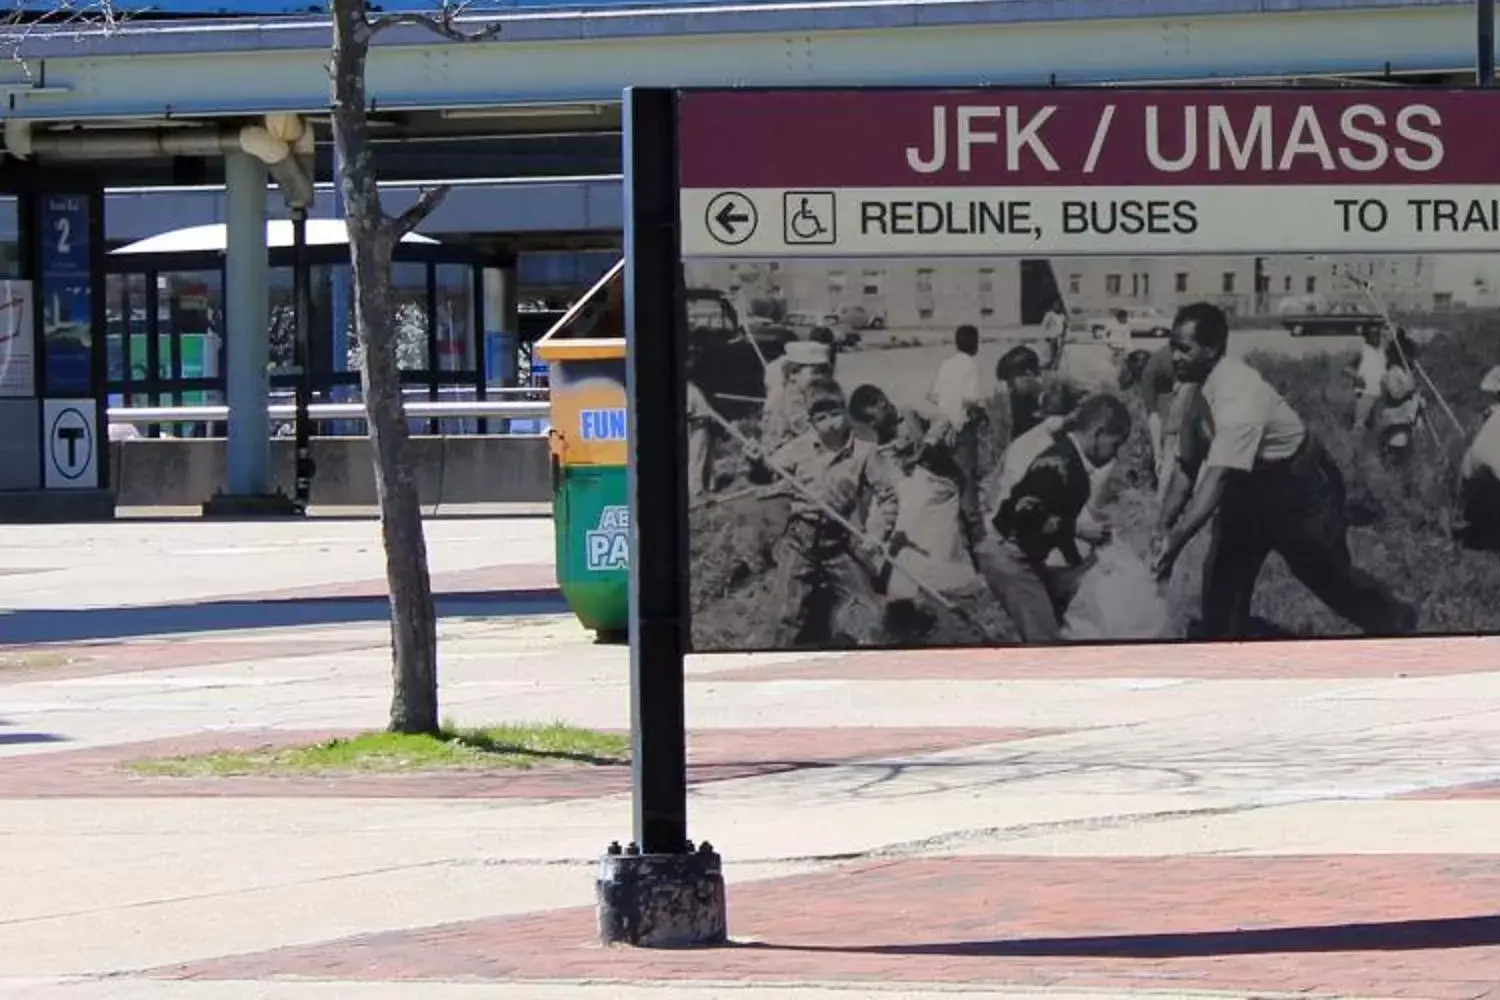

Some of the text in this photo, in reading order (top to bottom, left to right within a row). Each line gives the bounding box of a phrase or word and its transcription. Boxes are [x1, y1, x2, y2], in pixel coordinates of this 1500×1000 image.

[906, 105, 1060, 172] JFK
[1144, 104, 1444, 172] UMASS
[861, 200, 1198, 240] REDLINE, BUSES
[1333, 198, 1388, 232] TO
[55, 217, 71, 253] 2
[580, 409, 626, 440] FUN
[58, 427, 84, 467] T
